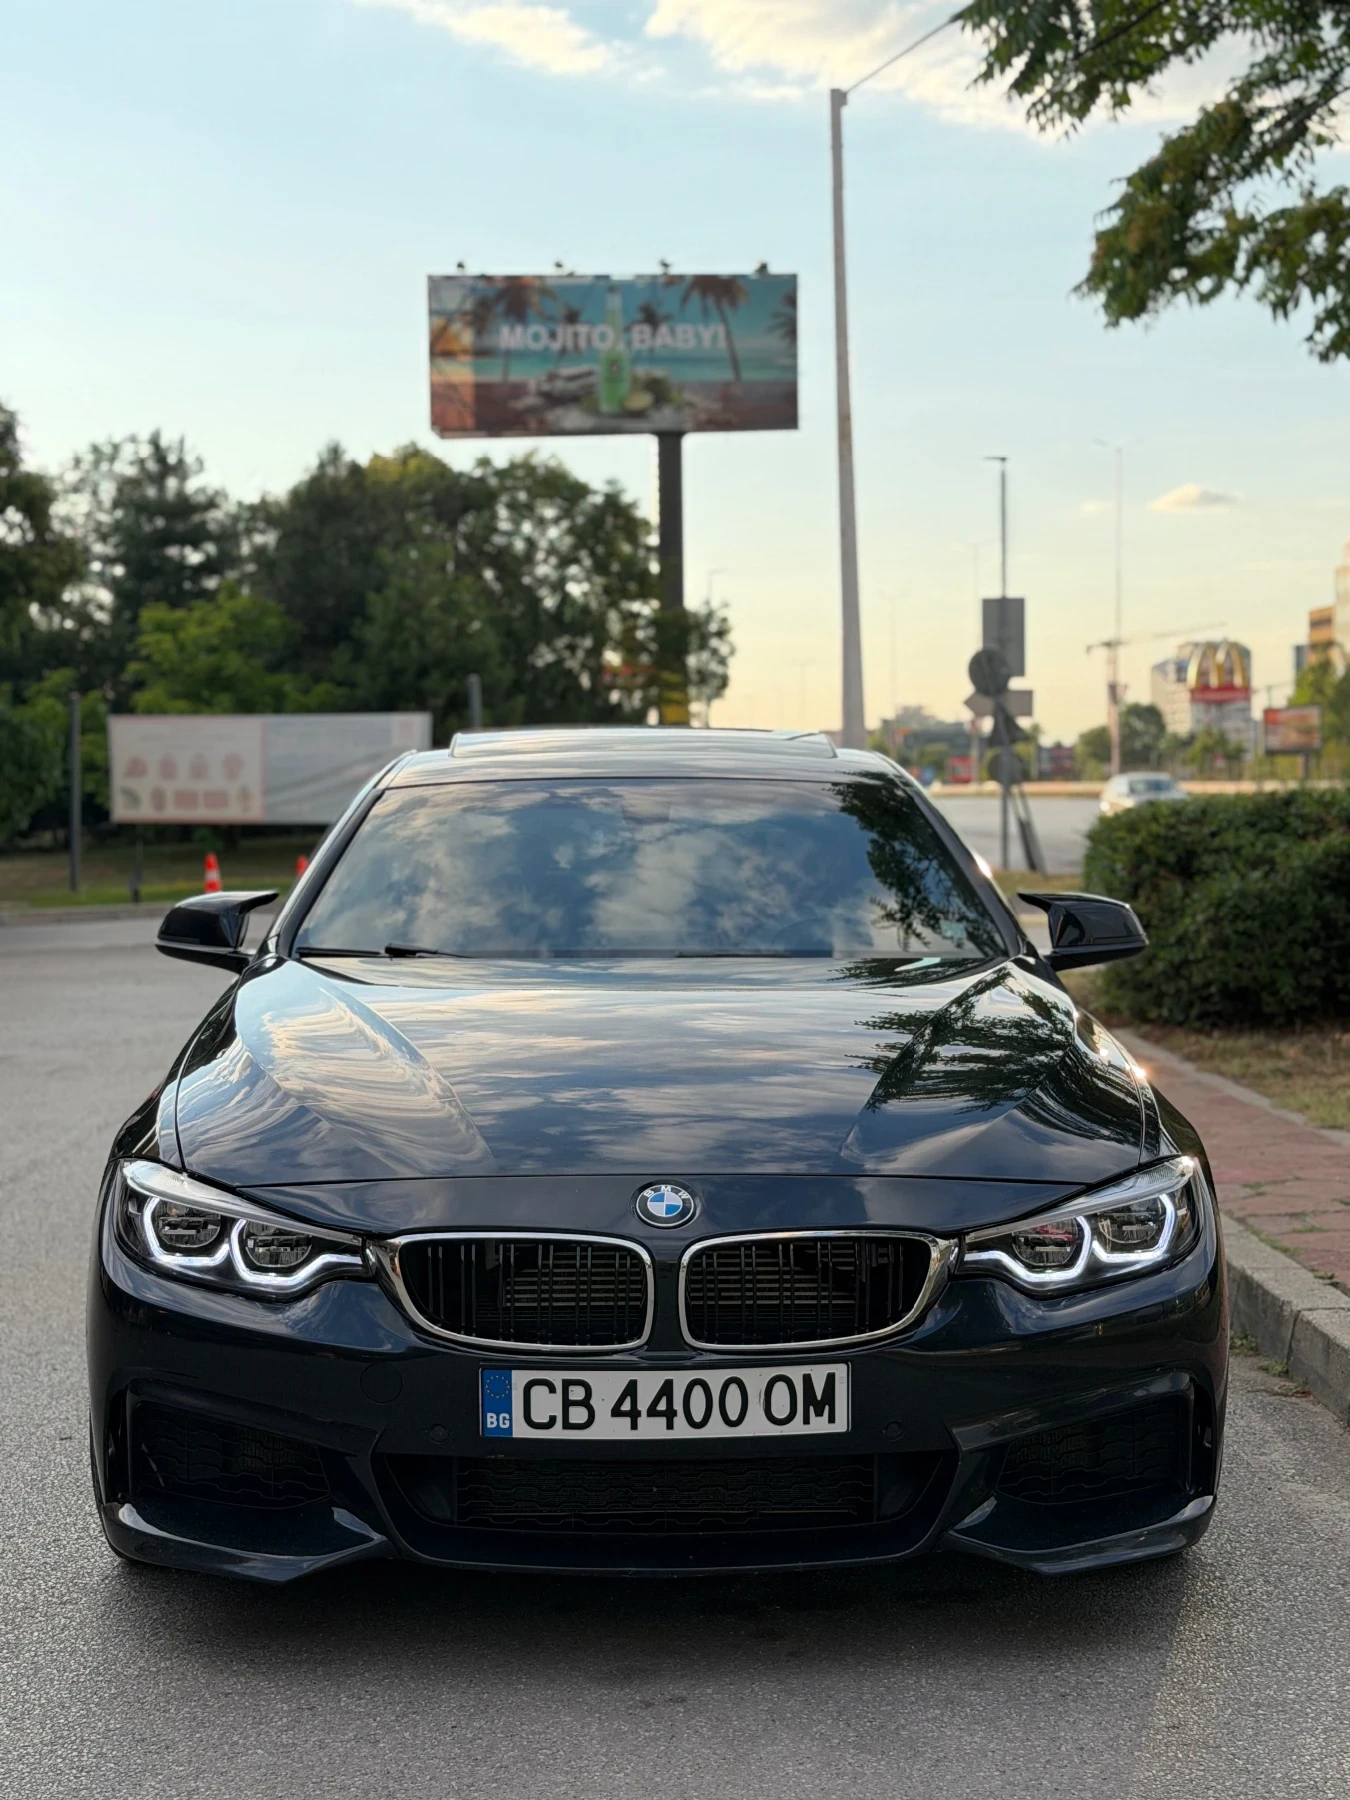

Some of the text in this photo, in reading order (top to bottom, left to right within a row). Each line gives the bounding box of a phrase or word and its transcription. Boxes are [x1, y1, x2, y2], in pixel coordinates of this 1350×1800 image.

[631, 323, 727, 349] BABY!
[643, 1185, 690, 1199] BMW
[522, 1372, 836, 1430] CB 4400 OM
[486, 1412, 510, 1428] BG
